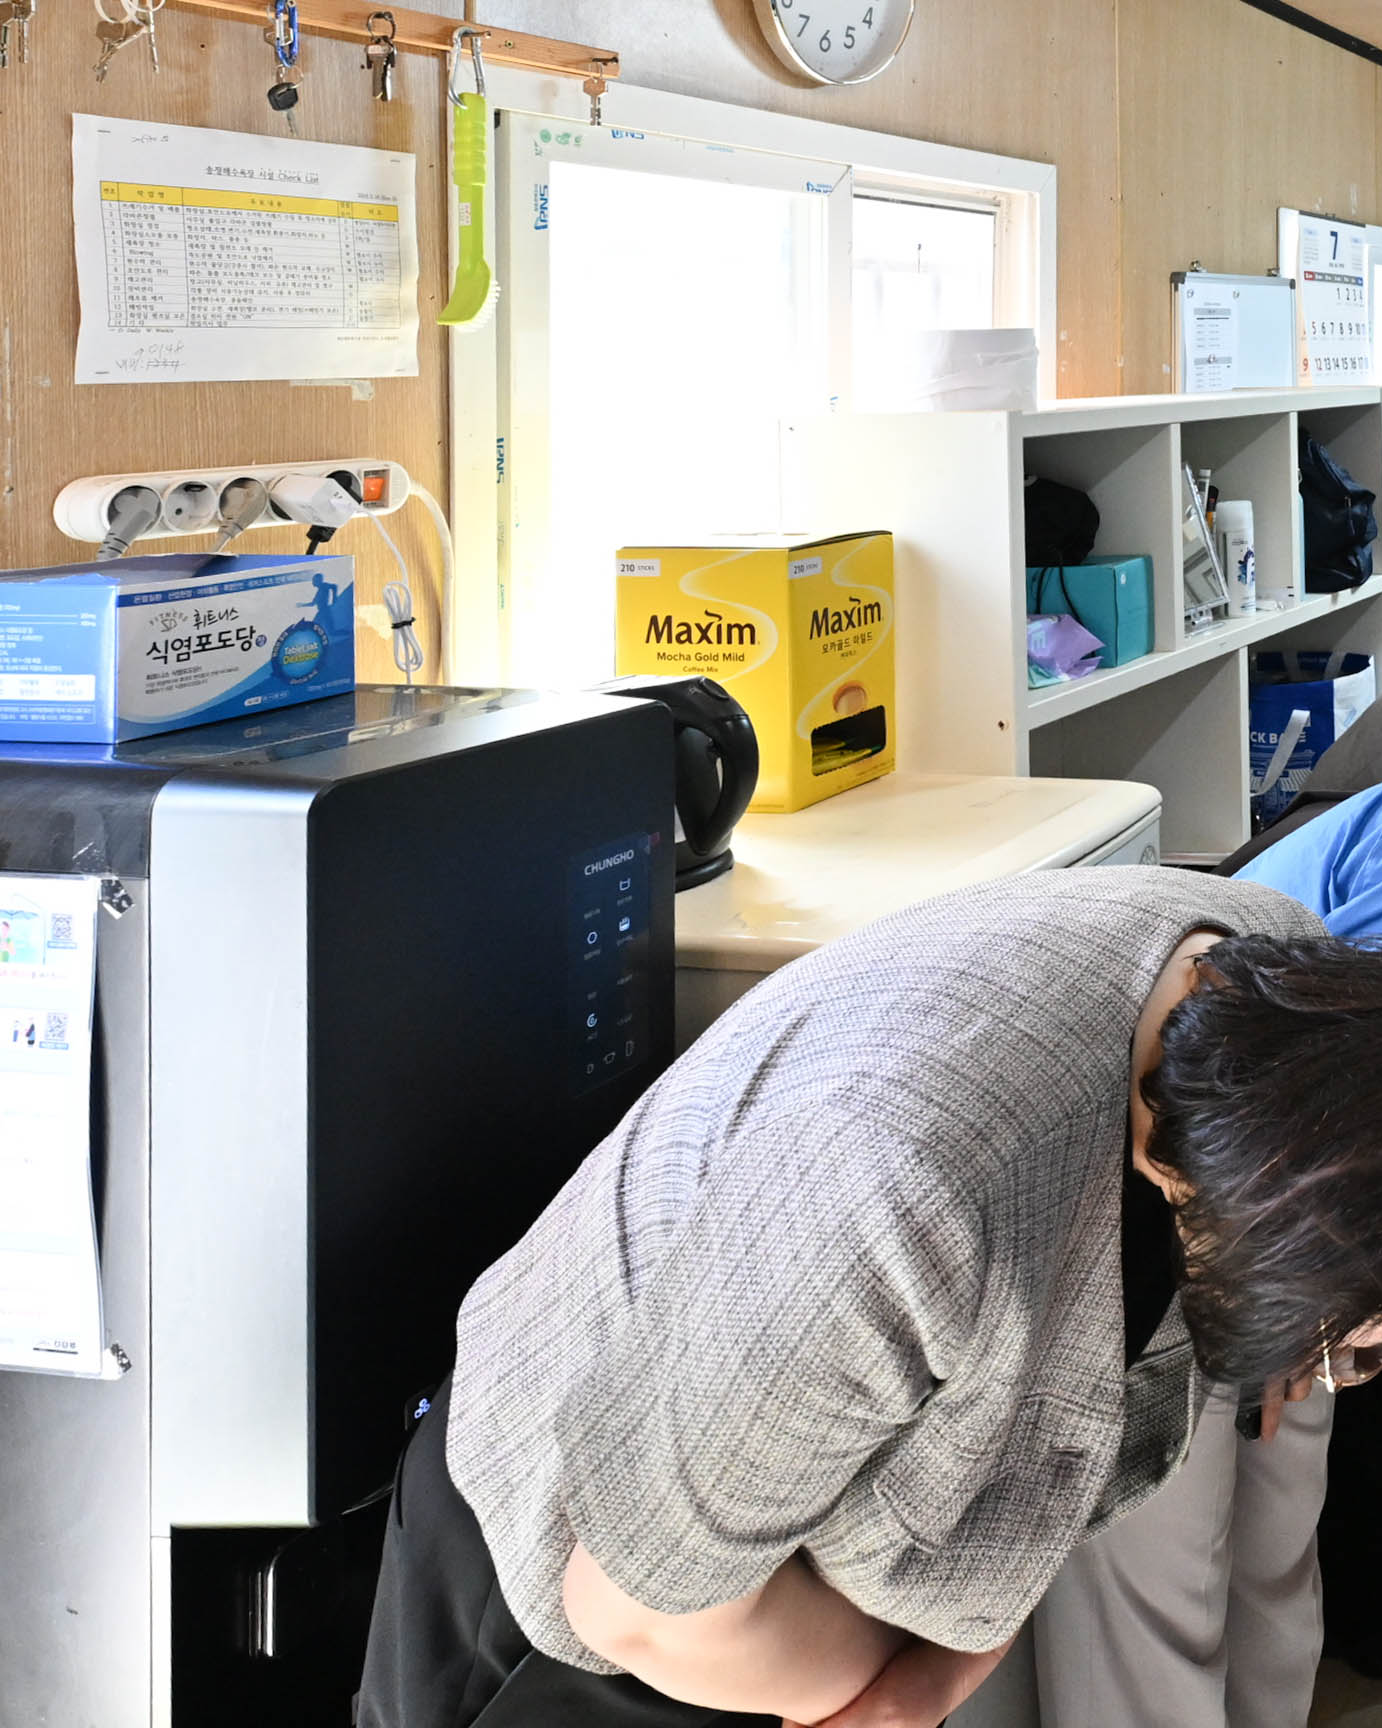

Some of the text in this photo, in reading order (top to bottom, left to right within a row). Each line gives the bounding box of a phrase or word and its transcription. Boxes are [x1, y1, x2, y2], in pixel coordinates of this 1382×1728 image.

[796, 14, 810, 38] 7
[862, 7, 873, 29] 4
[819, 29, 831, 53] 6
[843, 26, 855, 49] 5
[278, 171, 302, 182] Check
[304, 173, 320, 184] List
[1329, 230, 1339, 261] 7
[1311, 321, 1317, 335] 5
[1321, 321, 1326, 335] 6
[1330, 322, 1335, 335] 7
[1339, 322, 1344, 335] 8
[1315, 358, 1322, 370] 12
[1324, 358, 1331, 370] 13
[1332, 358, 1340, 370] 14
[1341, 358, 1348, 370] 15
[620, 564, 635, 573] 210
[793, 564, 805, 575] 210
[193, 606, 240, 630] 휘트니스
[644, 609, 756, 646] Maxim
[809, 596, 881, 640] Maxim
[146, 625, 256, 665] 식염포도당
[821, 631, 873, 654] 모카골드 마일드
[657, 652, 745, 662] Mocha Gold Mild
[583, 849, 635, 876] CHUNGHO
